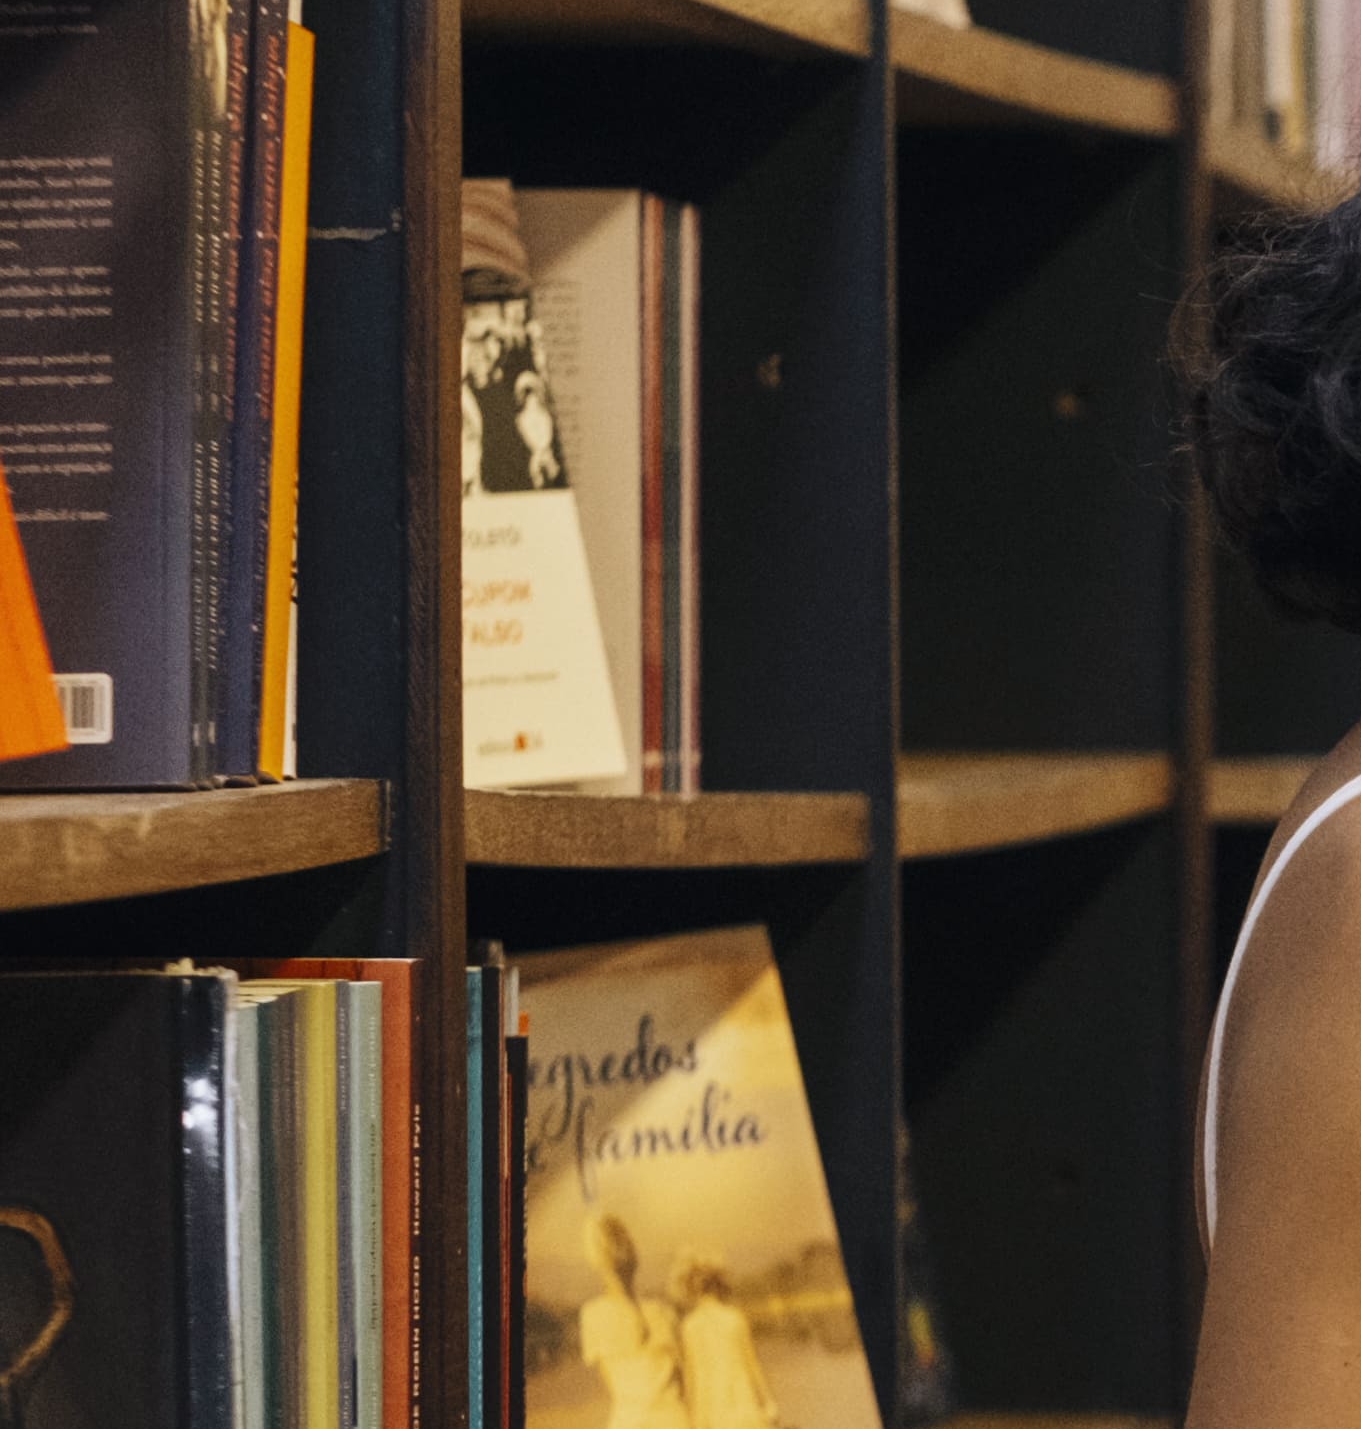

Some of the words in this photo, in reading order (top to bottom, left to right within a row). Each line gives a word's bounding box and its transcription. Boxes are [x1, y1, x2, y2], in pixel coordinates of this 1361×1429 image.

[463, 619, 523, 646] ALSO
[527, 1013, 699, 1143] egredos
[412, 1104, 421, 1148] Pyle
[576, 1079, 768, 1203] família
[412, 1155, 421, 1236] Howard
[412, 1255, 421, 1321] HOOD
